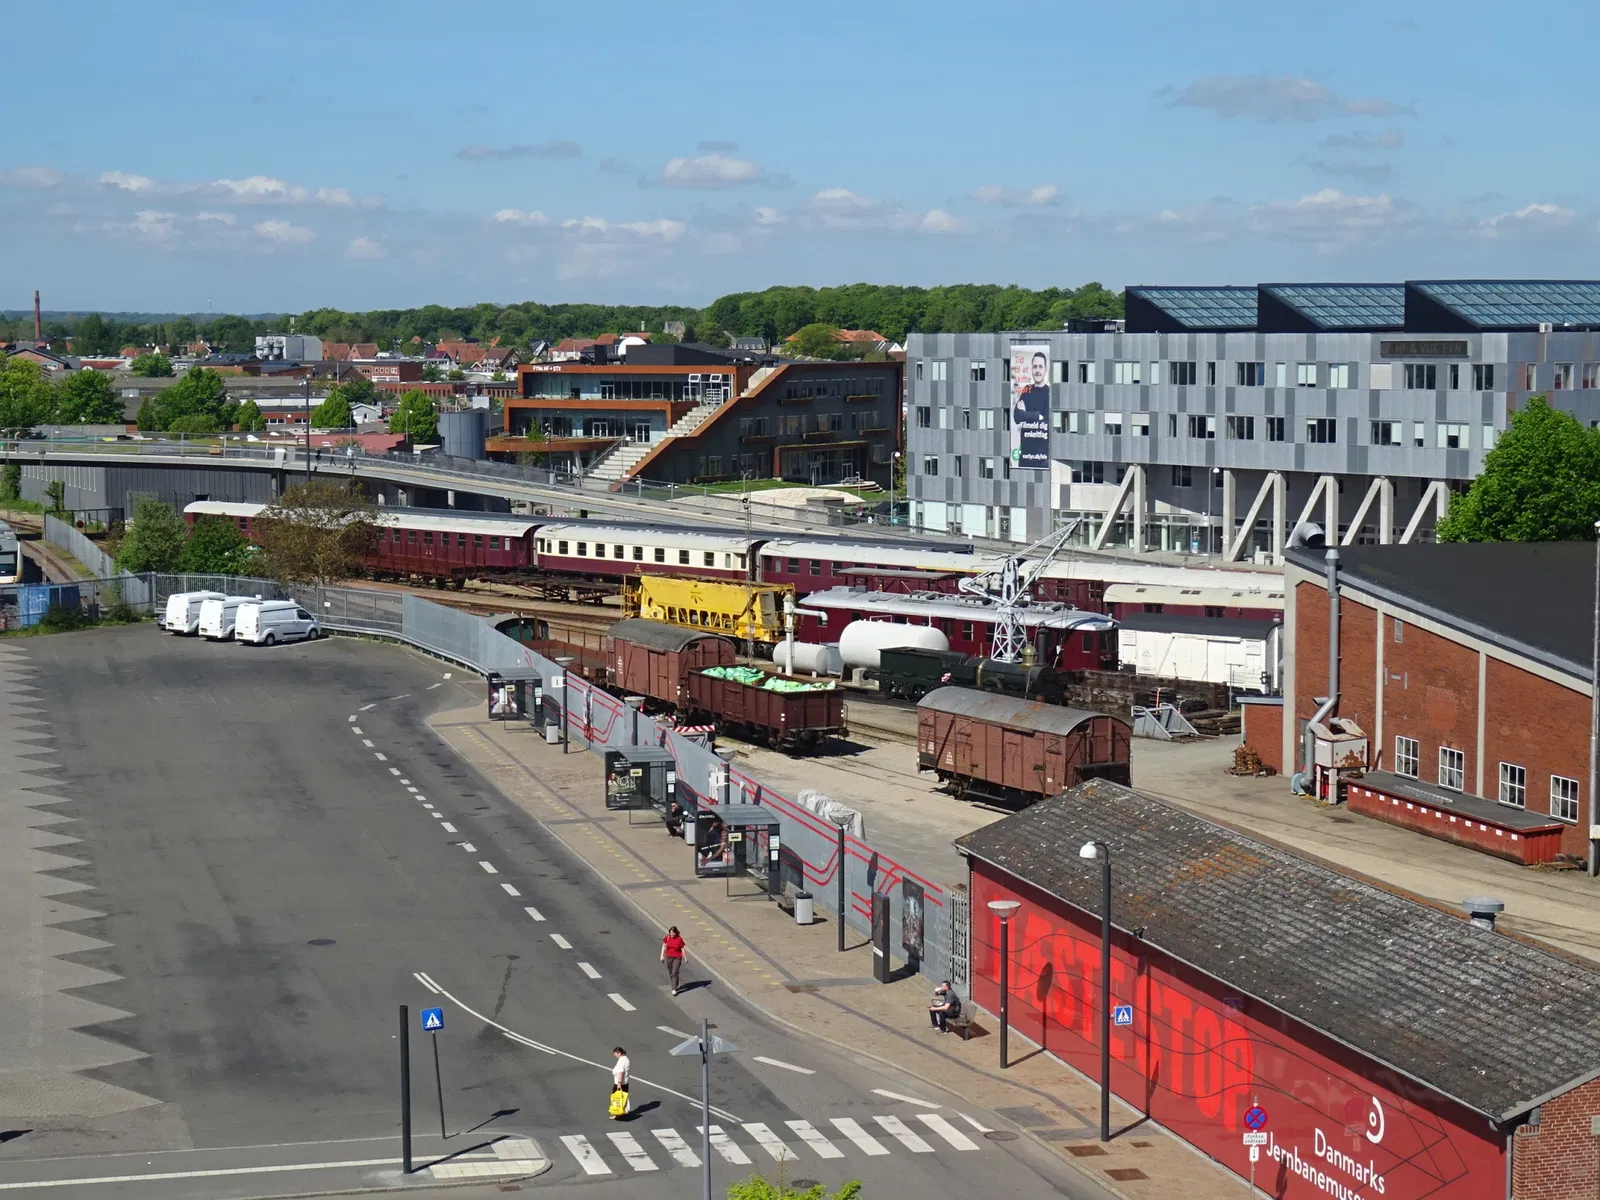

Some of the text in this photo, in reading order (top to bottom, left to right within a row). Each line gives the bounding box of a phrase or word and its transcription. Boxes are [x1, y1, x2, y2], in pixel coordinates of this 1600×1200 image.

[1015, 355, 1025, 363] Tid
[1136, 974, 1255, 1133] STOP
[1314, 1127, 1385, 1194] Danmarks
